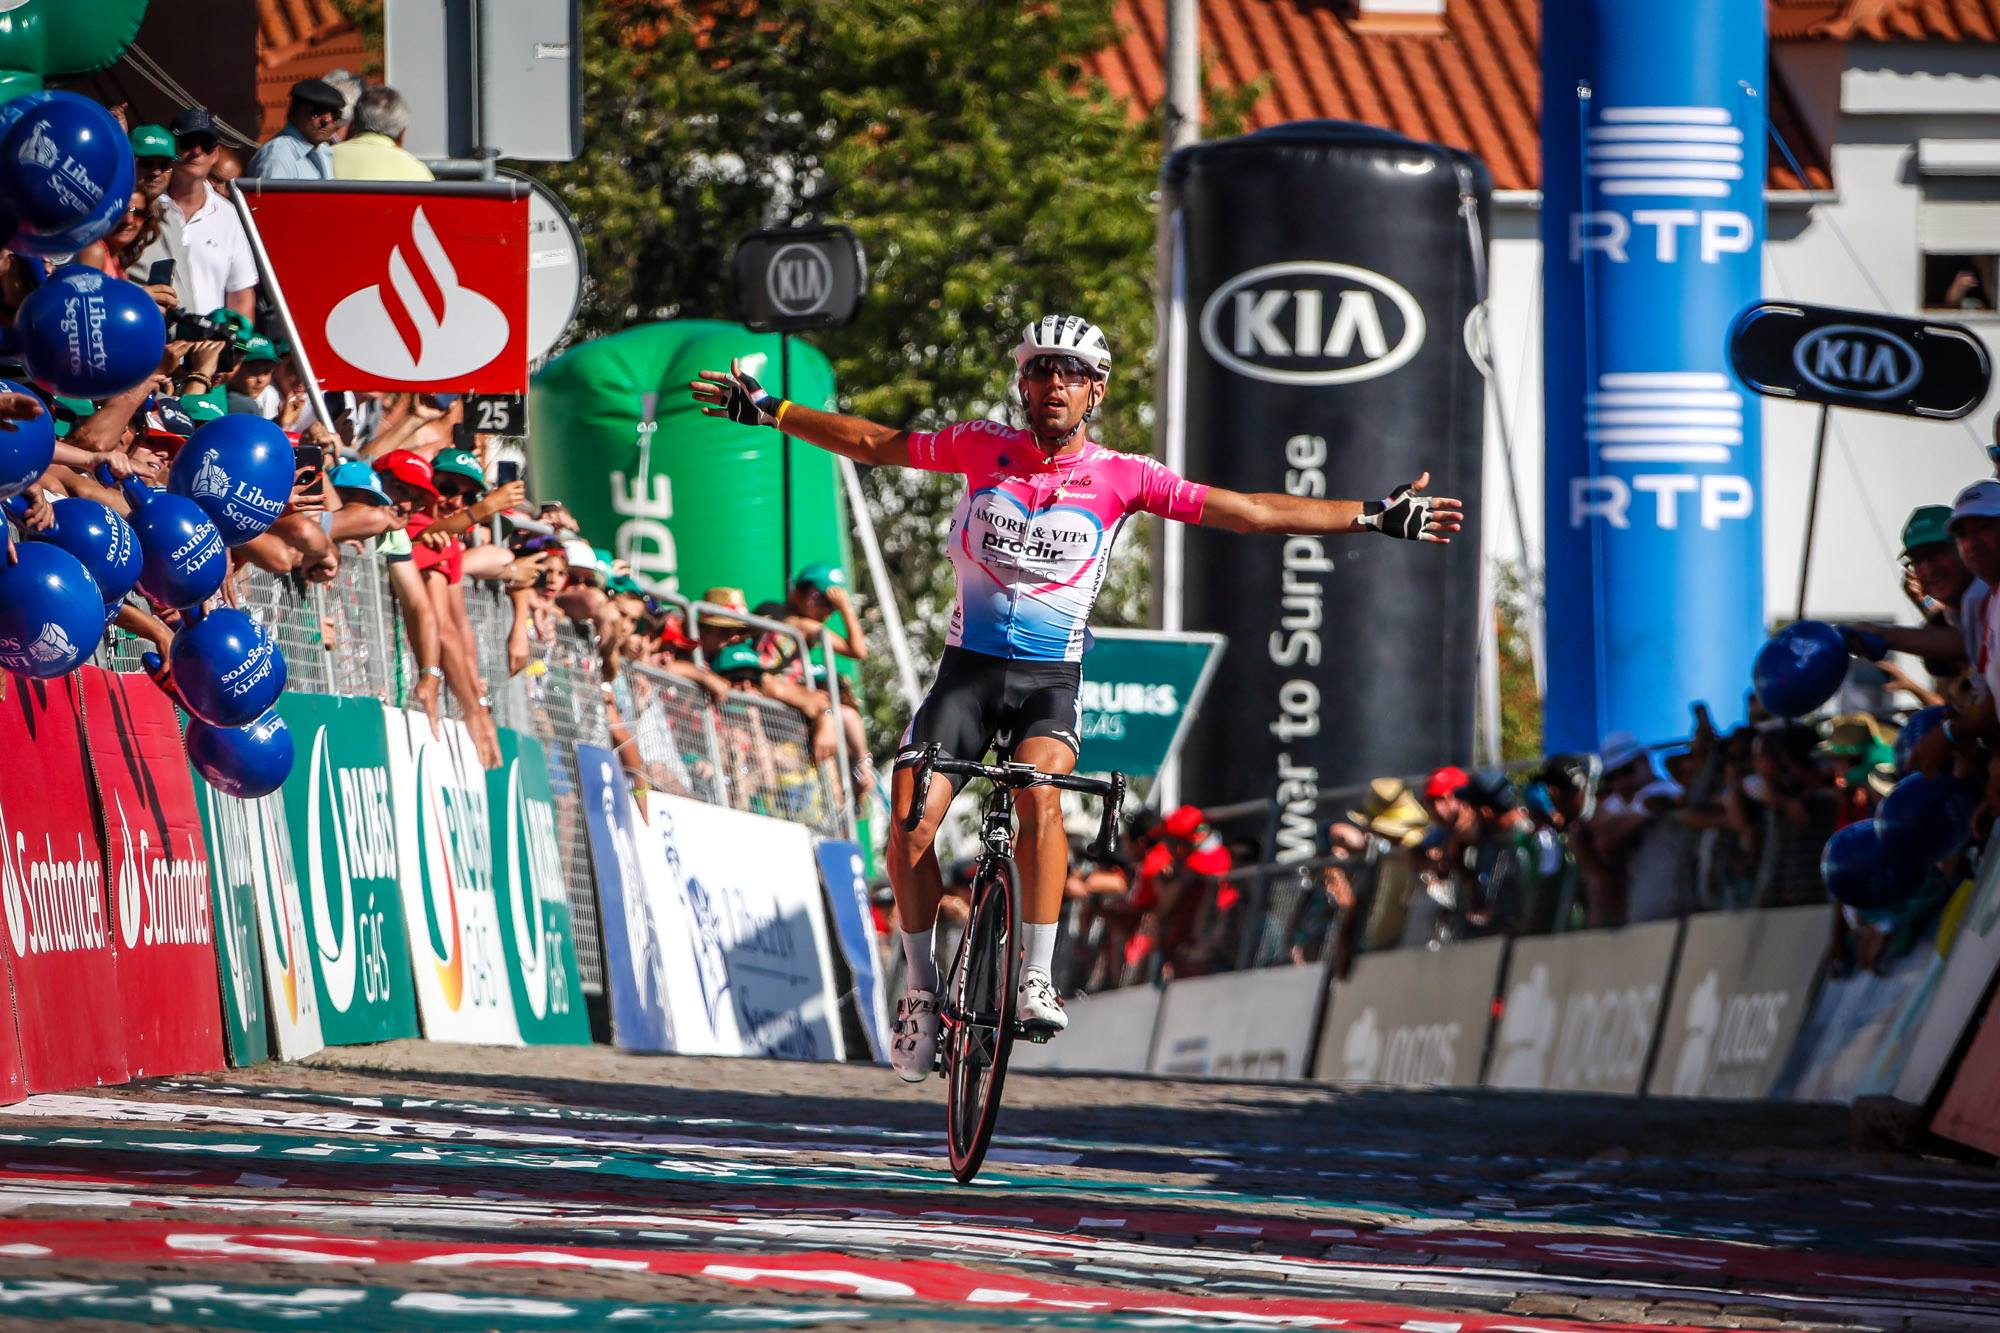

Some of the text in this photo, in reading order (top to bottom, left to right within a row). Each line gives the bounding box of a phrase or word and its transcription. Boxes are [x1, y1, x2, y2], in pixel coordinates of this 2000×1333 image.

[1569, 209, 1754, 264] RTP
[778, 259, 821, 300] KIA
[60, 297, 81, 376] Seguros
[88, 296, 107, 372] Liberty
[1233, 289, 1389, 358] KIA
[1814, 338, 1898, 385] KIA
[477, 400, 509, 430] 25
[1569, 475, 1754, 530] RTP
[171, 519, 216, 562] Seguros
[186, 534, 225, 575] Liberty
[982, 531, 1064, 560] prodir
[1032, 526, 1046, 539] &
[1051, 529, 1088, 543] VITA
[1269, 434, 1334, 667] Surpse
[1269, 680, 1321, 742] to
[16, 830, 105, 954] Santander
[140, 829, 210, 945] Santander
